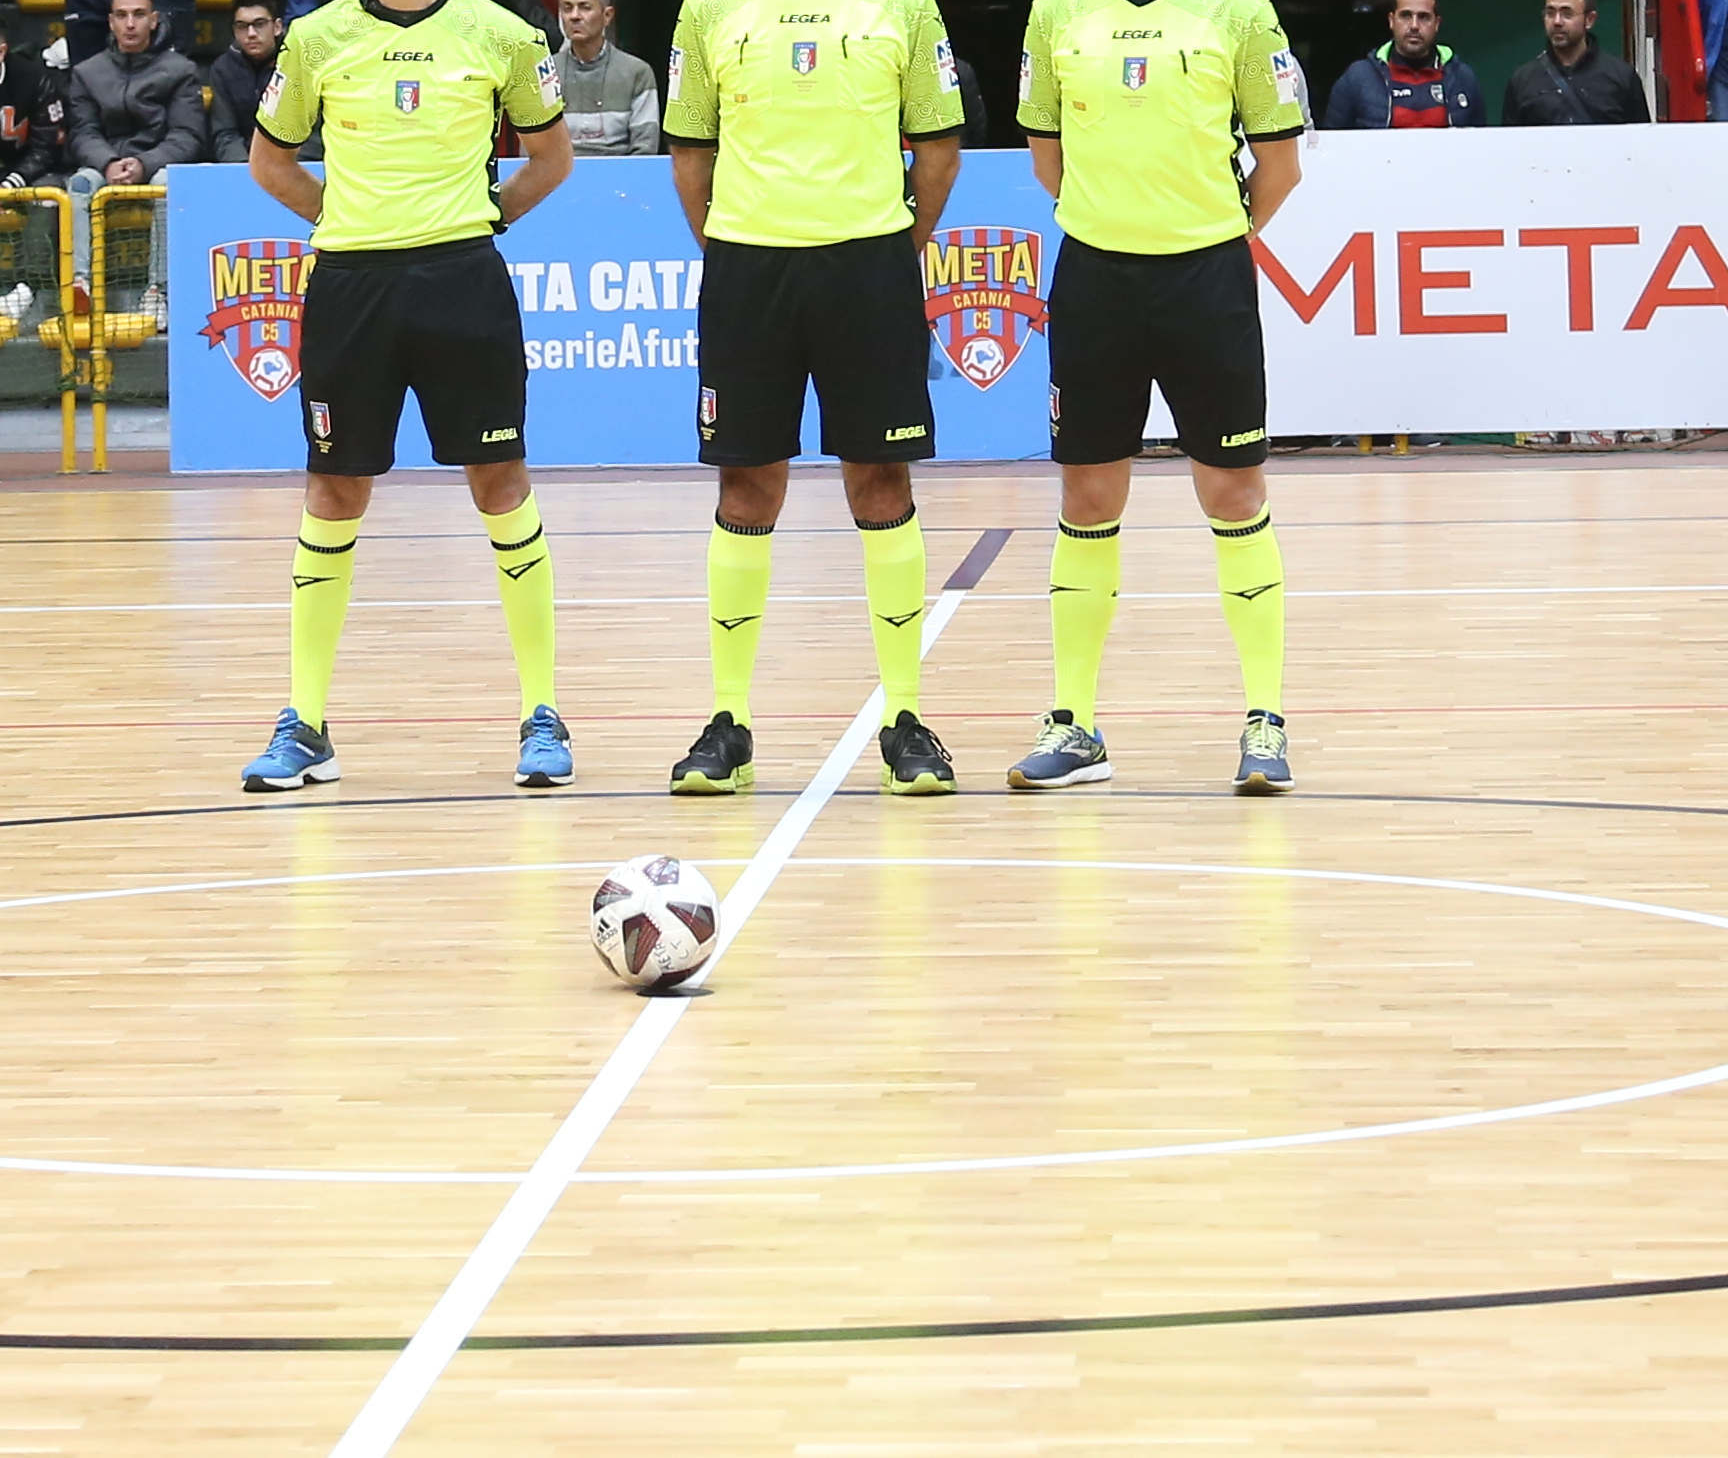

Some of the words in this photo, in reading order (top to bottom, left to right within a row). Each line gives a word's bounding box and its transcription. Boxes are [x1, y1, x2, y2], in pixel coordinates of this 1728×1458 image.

[779, 13, 831, 24] LEGEA
[1112, 28, 1163, 39] LEGEA
[383, 51, 434, 62] LEGEA
[926, 240, 1037, 289] META
[216, 252, 317, 301] META
[509, 262, 577, 313] TA
[589, 260, 702, 312] CATA
[953, 290, 1012, 309] CATANIA
[241, 302, 299, 321] CATANIA
[972, 310, 991, 331] C5
[260, 322, 279, 341] C5
[525, 322, 699, 371] serieAfut
[1221, 427, 1265, 447] LEGEA
